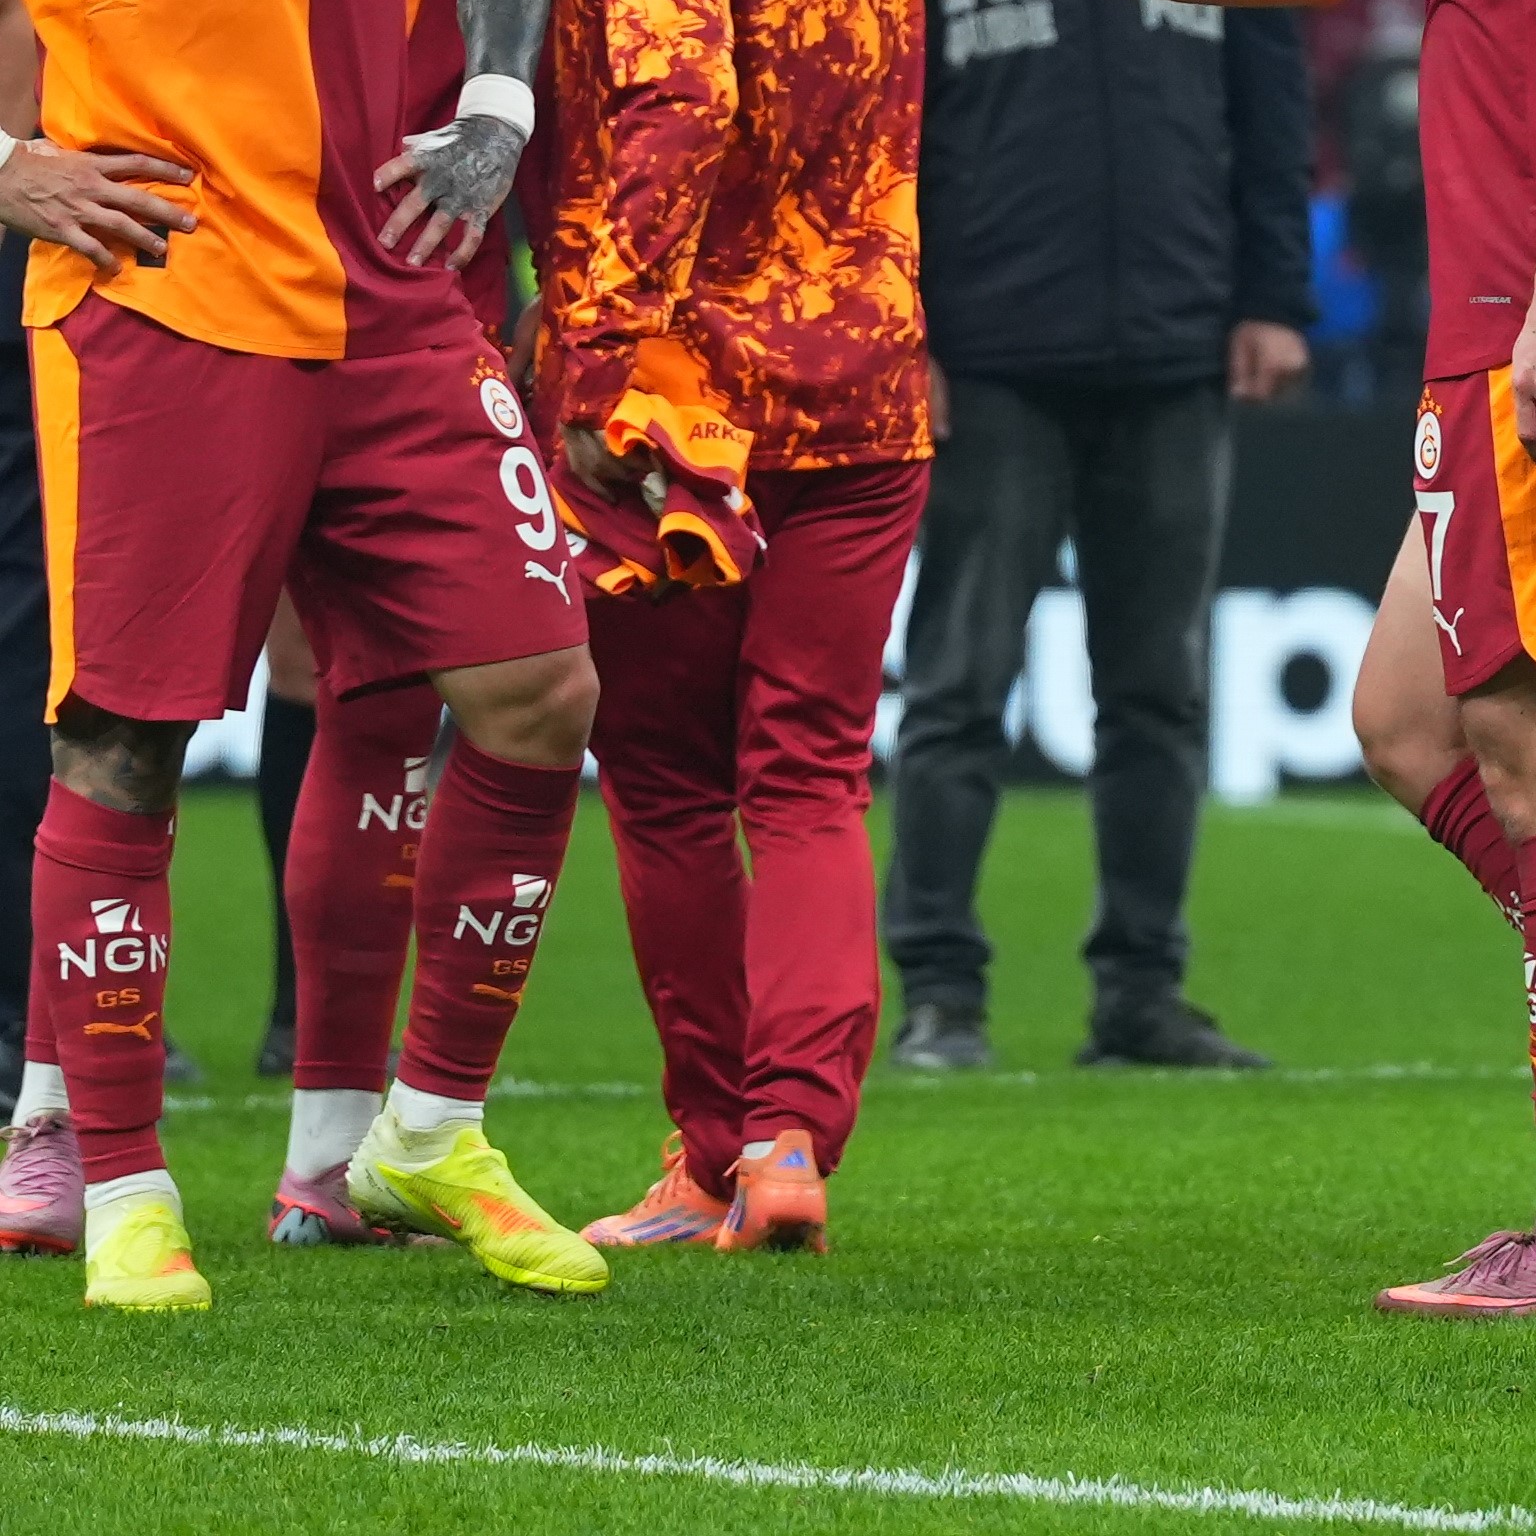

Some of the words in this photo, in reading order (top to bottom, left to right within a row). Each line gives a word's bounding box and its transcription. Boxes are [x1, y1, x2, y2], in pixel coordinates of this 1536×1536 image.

[688, 421, 742, 444] ARK
[499, 446, 557, 551] 9
[1414, 490, 1456, 601] 7
[358, 792, 427, 831] NG
[453, 904, 540, 946] NG
[96, 987, 141, 1008] GS
